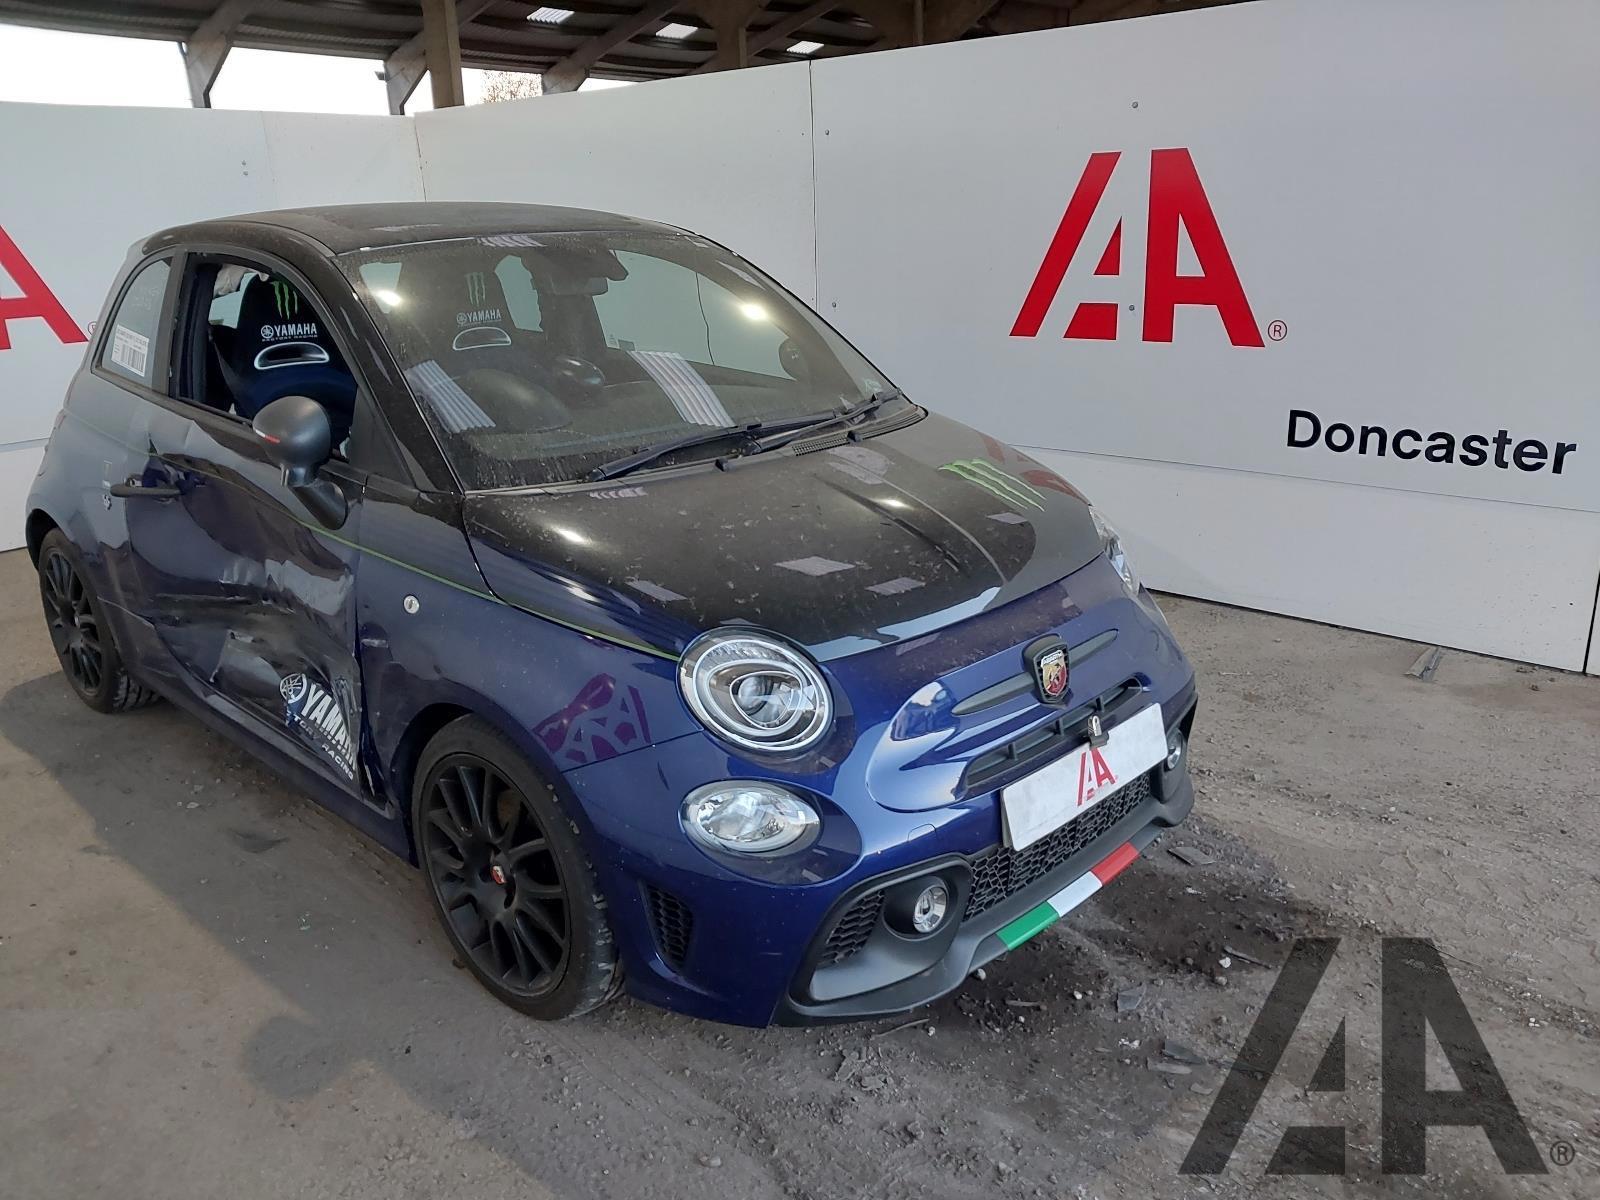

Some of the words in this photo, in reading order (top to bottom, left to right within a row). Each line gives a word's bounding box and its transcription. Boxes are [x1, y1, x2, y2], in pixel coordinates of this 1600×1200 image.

[467, 308, 502, 322] YAMAHA
[273, 322, 317, 337] YAMAHA
[1287, 409, 1577, 475] Doncaster
